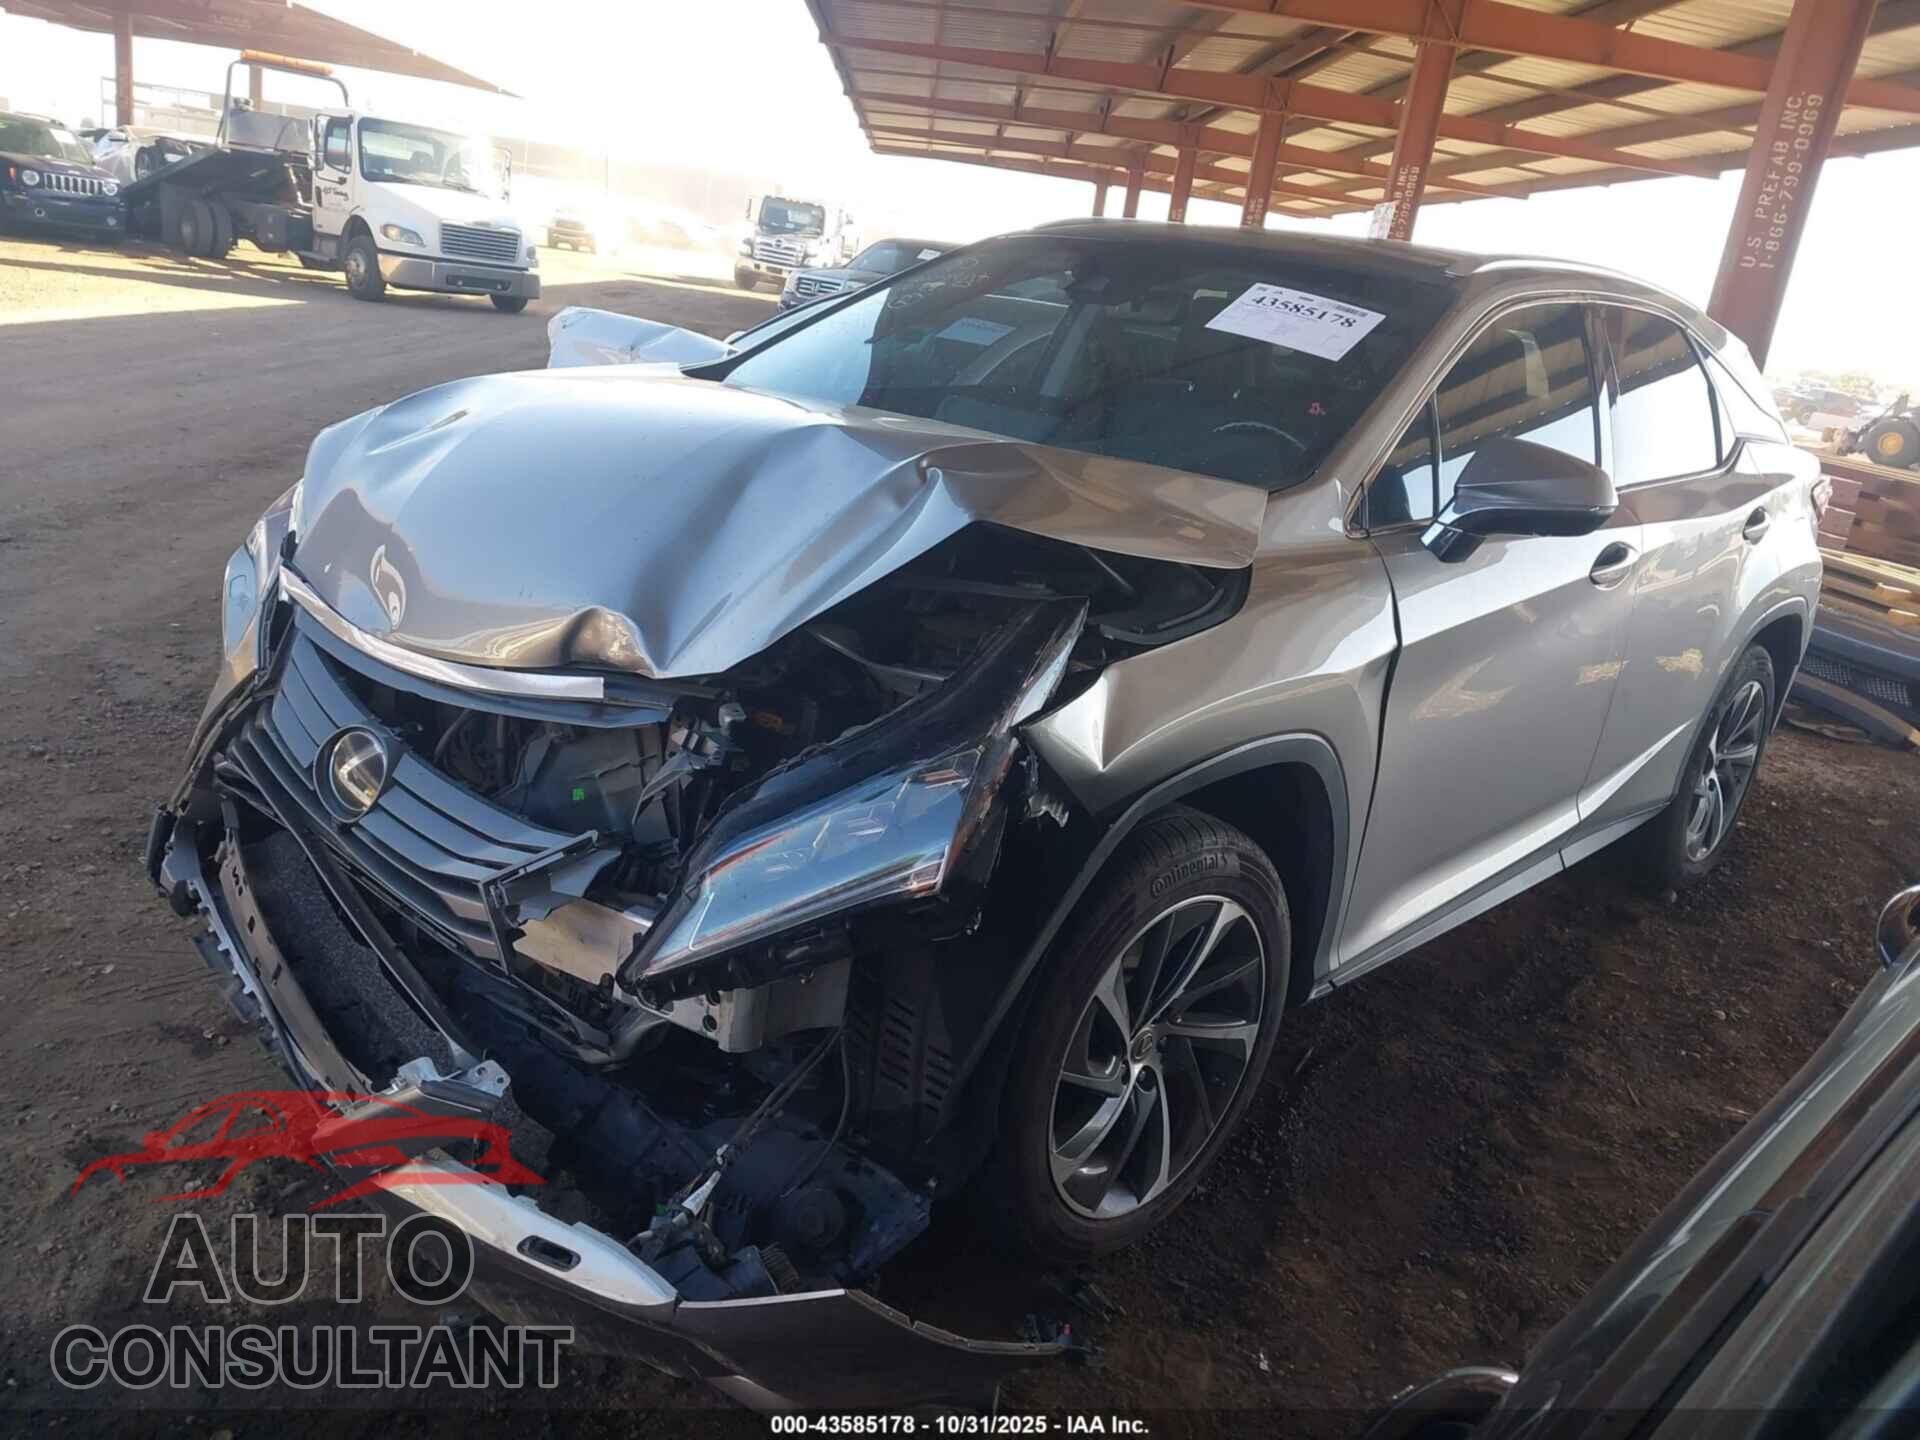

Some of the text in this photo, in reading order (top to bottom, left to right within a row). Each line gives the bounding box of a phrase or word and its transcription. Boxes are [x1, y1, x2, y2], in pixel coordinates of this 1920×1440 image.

[1754, 140, 1790, 219] PREFAB
[1780, 91, 1807, 130] INC.
[1759, 93, 1823, 269] 1-866-799-0969
[1252, 295, 1358, 328] 43585178
